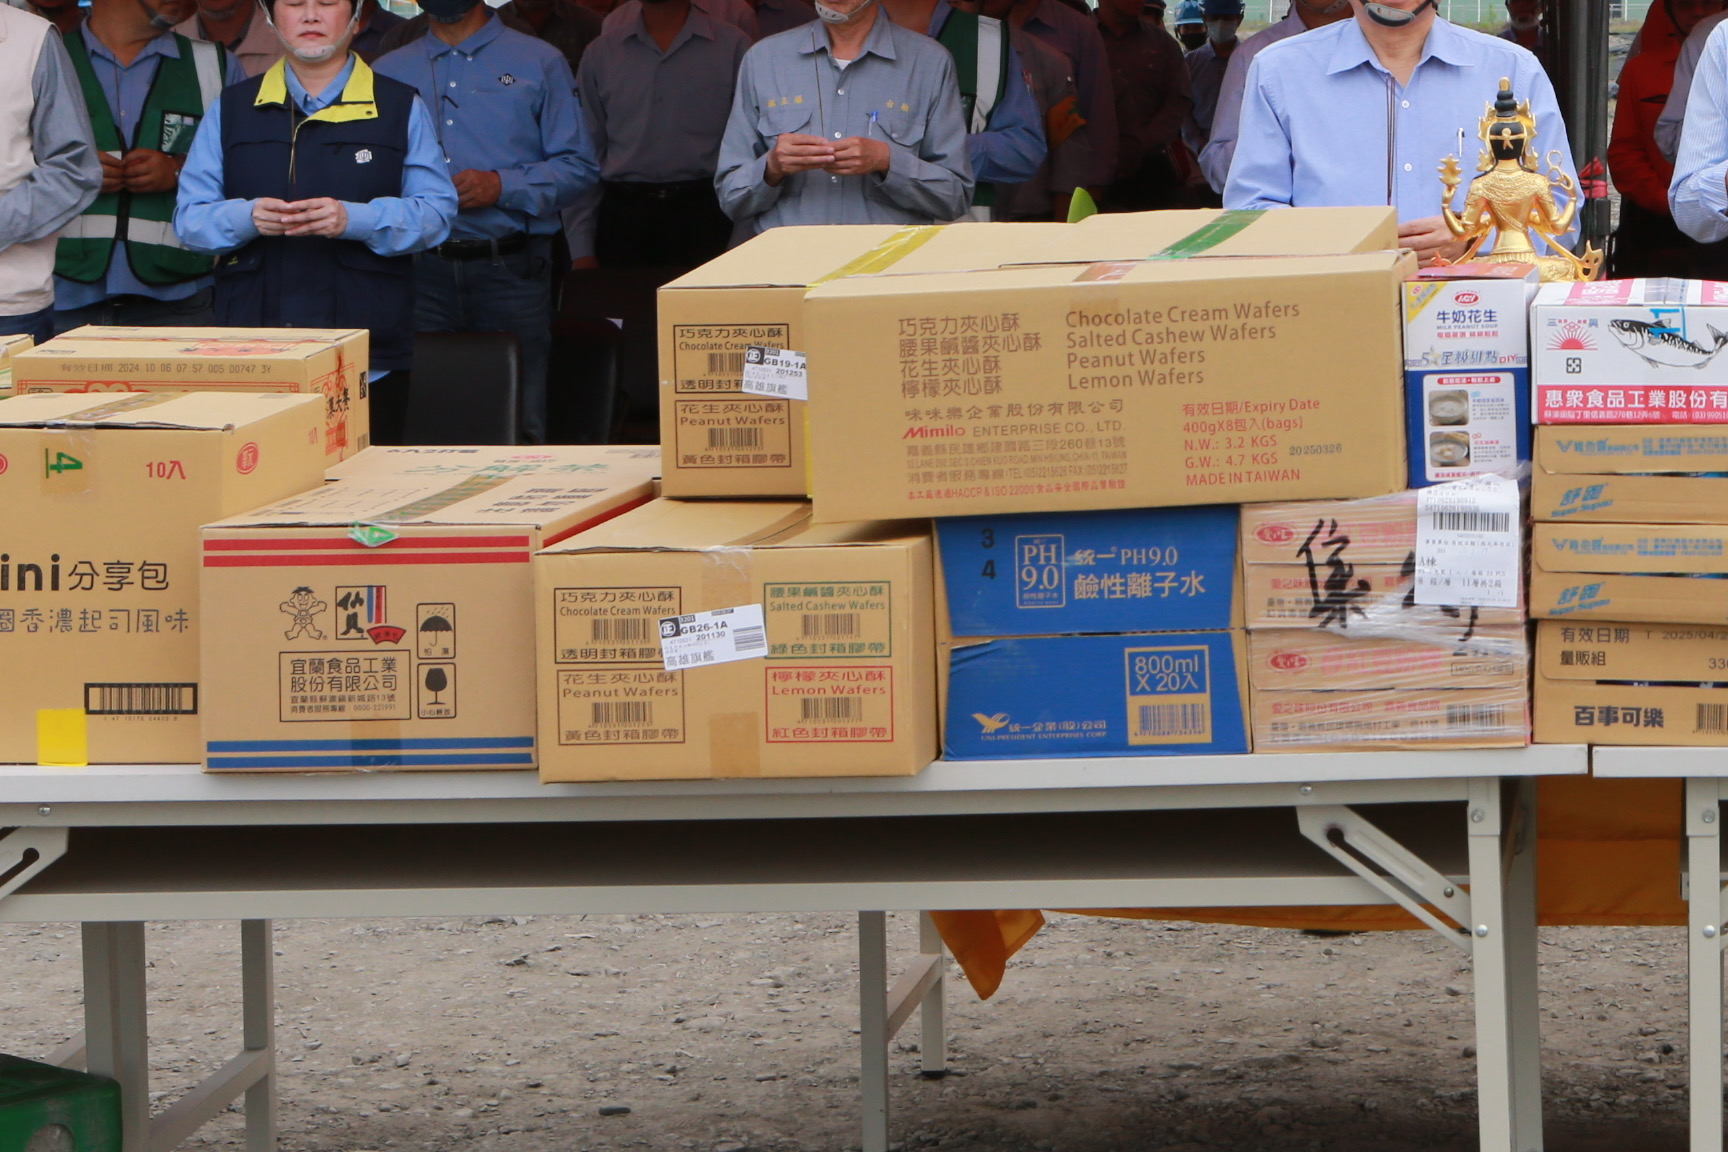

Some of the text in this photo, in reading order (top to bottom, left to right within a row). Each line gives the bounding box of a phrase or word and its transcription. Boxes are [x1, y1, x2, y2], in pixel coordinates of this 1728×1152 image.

[1065, 301, 1300, 329] Chocolate Cream Wafers
[1436, 309, 1498, 324] 牛奶花生
[679, 327, 783, 339] 巧克力夾心酥
[898, 312, 1021, 338] 巧克力夾心酥
[1066, 323, 1277, 348] Salted Cashew Wafers
[899, 332, 1043, 359] 腰果鹹醬夾心酥
[763, 357, 807, 370] GB19-1A
[900, 354, 1002, 379] 花生夾心酥
[1067, 348, 1206, 370] Peanut Wafers
[776, 368, 803, 378] 201253
[1067, 368, 1205, 390] Lemon Wafers
[901, 375, 1003, 399] 檸檬夾心酥
[680, 402, 785, 415] 花生夾心酥
[904, 398, 1124, 422] 咪咪樂企業股份有限公司
[1183, 398, 1320, 417] 有效日期/Expiry Date
[680, 416, 786, 426] Peanut Wafers
[902, 423, 966, 440] Mimilo
[973, 422, 1061, 438] ENTERPRISE
[1225, 436, 1245, 450] 3.2
[1251, 434, 1278, 448] KGS
[1289, 443, 1343, 456] 20250326
[681, 454, 786, 466] 黃色封箱膠帶
[1225, 454, 1246, 467] 4.7
[1251, 452, 1279, 466] KGS
[146, 460, 187, 480] 10入
[1186, 468, 1302, 487] MADE IN TAIWAN
[981, 528, 995, 549] 3
[1022, 544, 1058, 565] PH
[1073, 549, 1116, 566] 統一
[1021, 565, 1060, 590] 9.0
[1074, 571, 1206, 600] 鹼性離子水
[560, 591, 675, 604] 巧克力夾心酥
[769, 600, 886, 612] Salted Cashew Wafers
[680, 620, 729, 635] GB26-1A
[1560, 627, 1631, 644] 有效日期
[695, 631, 726, 642] 201130
[769, 643, 886, 656] 綠色封箱膠帶
[290, 656, 398, 676] 宜蘭食品工業
[1135, 654, 1199, 674] 800ml
[1560, 650, 1607, 667] 量販組
[290, 674, 397, 693] 股份有限公司
[563, 672, 678, 686] 花生夾心酥
[771, 670, 887, 683] 檸檬夾心酥
[1136, 672, 1199, 692] X 20入
[772, 685, 887, 696] Lemon Wafers
[1574, 704, 1665, 728] 百事可樂
[771, 726, 888, 740] 紅色封箱膠帶
[1008, 719, 1107, 732] 統一企業(股)公司
[564, 729, 681, 742] 黃色封箱膠帶
